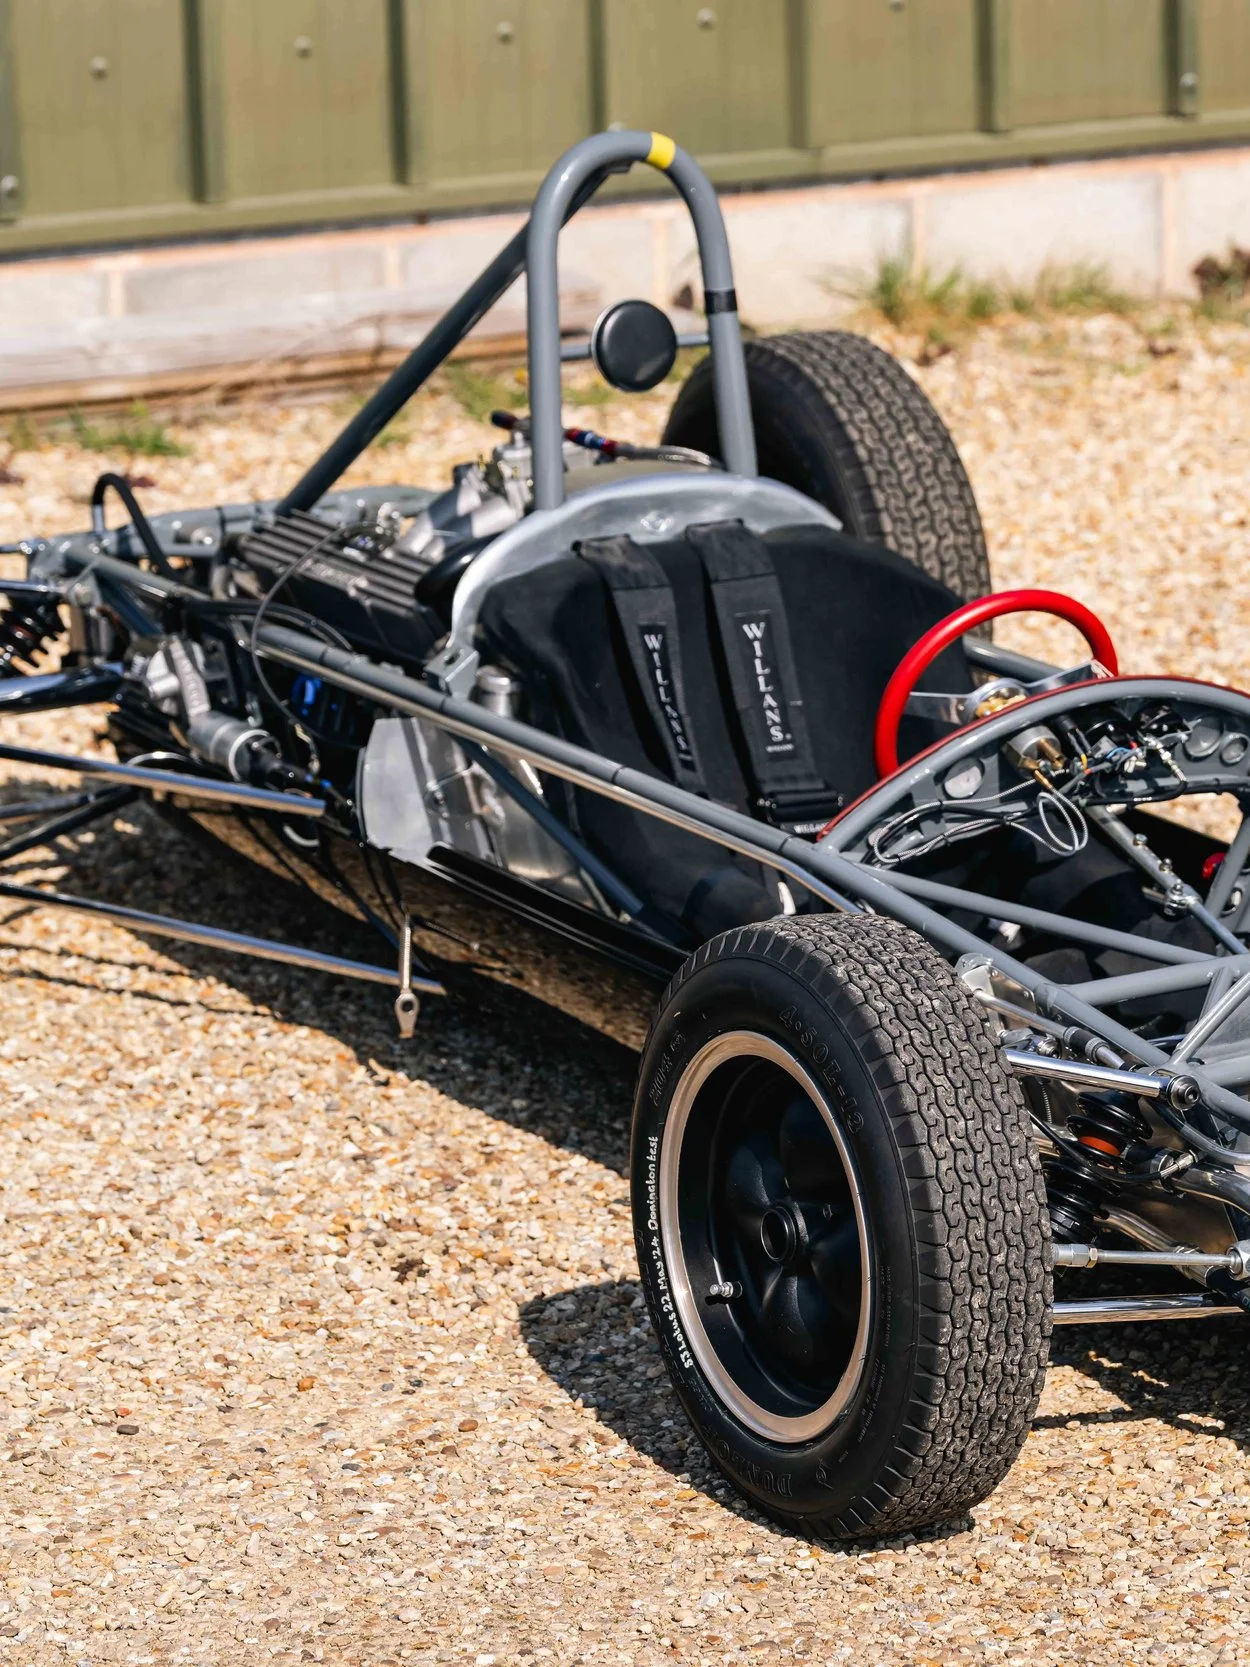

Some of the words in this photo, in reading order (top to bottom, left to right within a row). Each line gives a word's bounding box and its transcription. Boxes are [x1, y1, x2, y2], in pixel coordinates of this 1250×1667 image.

[742, 621, 784, 742] WILLANS
[646, 1136, 659, 1161] test
[655, 1262, 667, 1290] May
[660, 1292, 674, 1313] 22
[667, 1311, 687, 1351] Lotus
